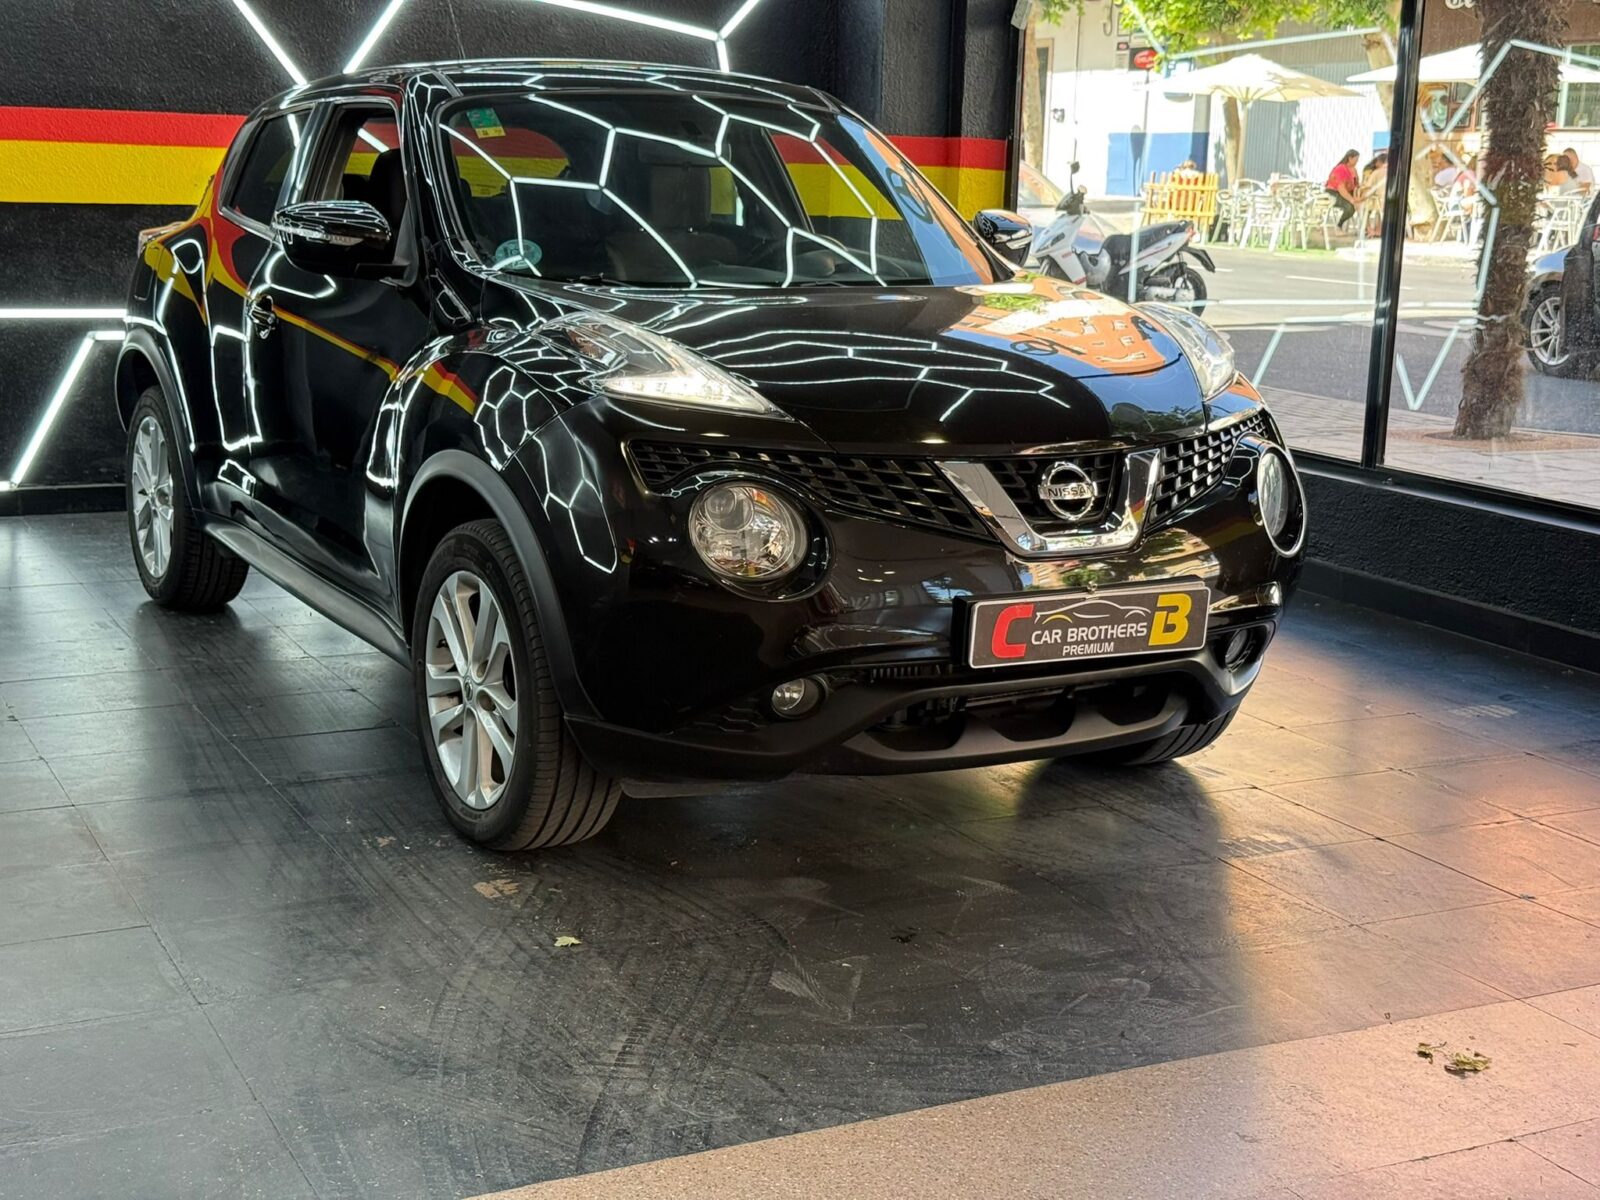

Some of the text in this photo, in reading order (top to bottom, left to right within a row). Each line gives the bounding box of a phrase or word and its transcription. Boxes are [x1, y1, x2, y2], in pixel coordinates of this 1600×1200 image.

[1047, 484, 1093, 497] NISSAN
[992, 602, 1034, 659] C
[1031, 622, 1148, 646] CAR BROTHERS
[1061, 642, 1115, 657] PREMIUM
